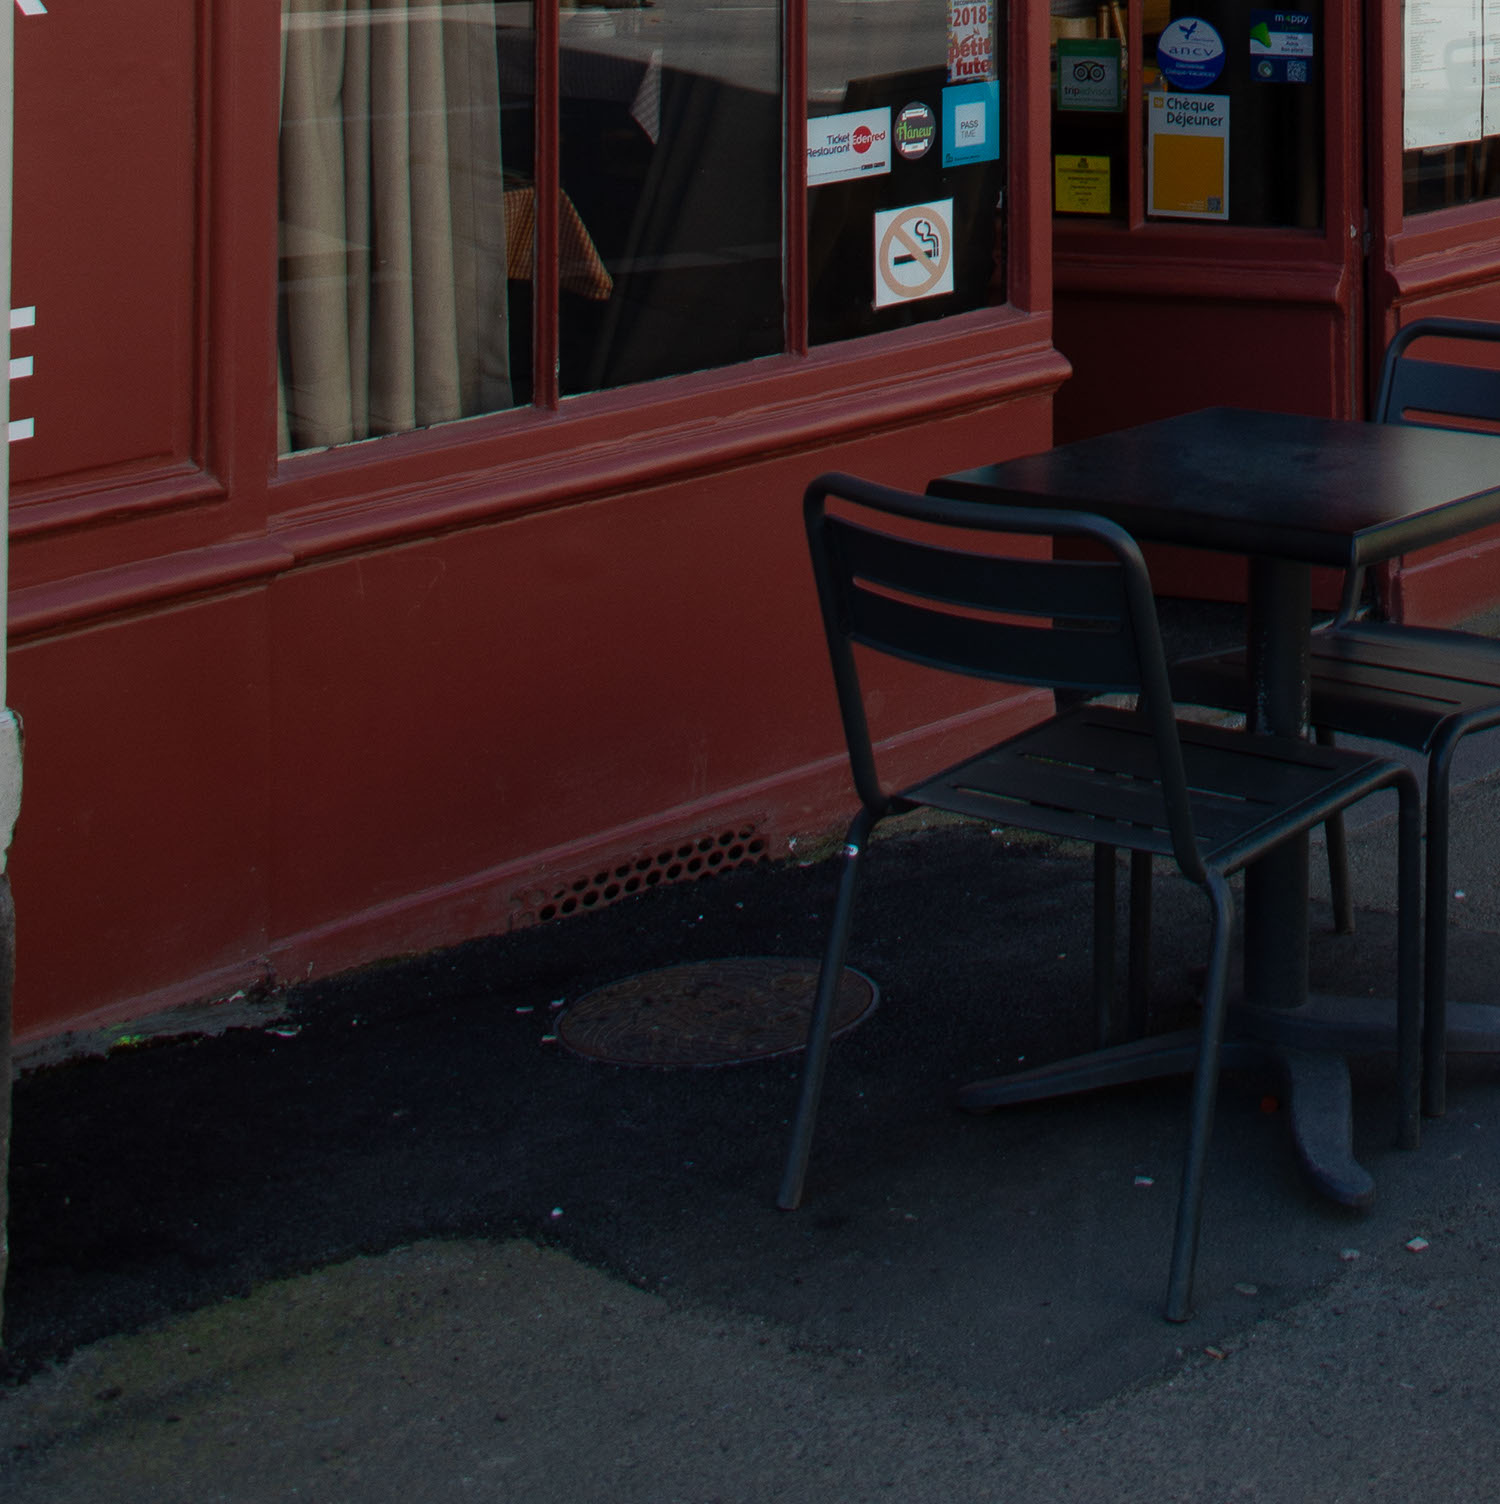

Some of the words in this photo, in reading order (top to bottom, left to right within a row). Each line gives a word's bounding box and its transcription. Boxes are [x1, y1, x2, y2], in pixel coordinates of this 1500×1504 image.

[953, 5, 987, 27] 2018
[1169, 47, 1214, 56] ancv
[1166, 97, 1215, 113] Chèque
[960, 120, 978, 129] PASS
[1166, 112, 1223, 128] Déjeuner
[827, 132, 850, 146] Ticket
[853, 130, 886, 146] Edenred
[807, 144, 850, 158] Restaurant
